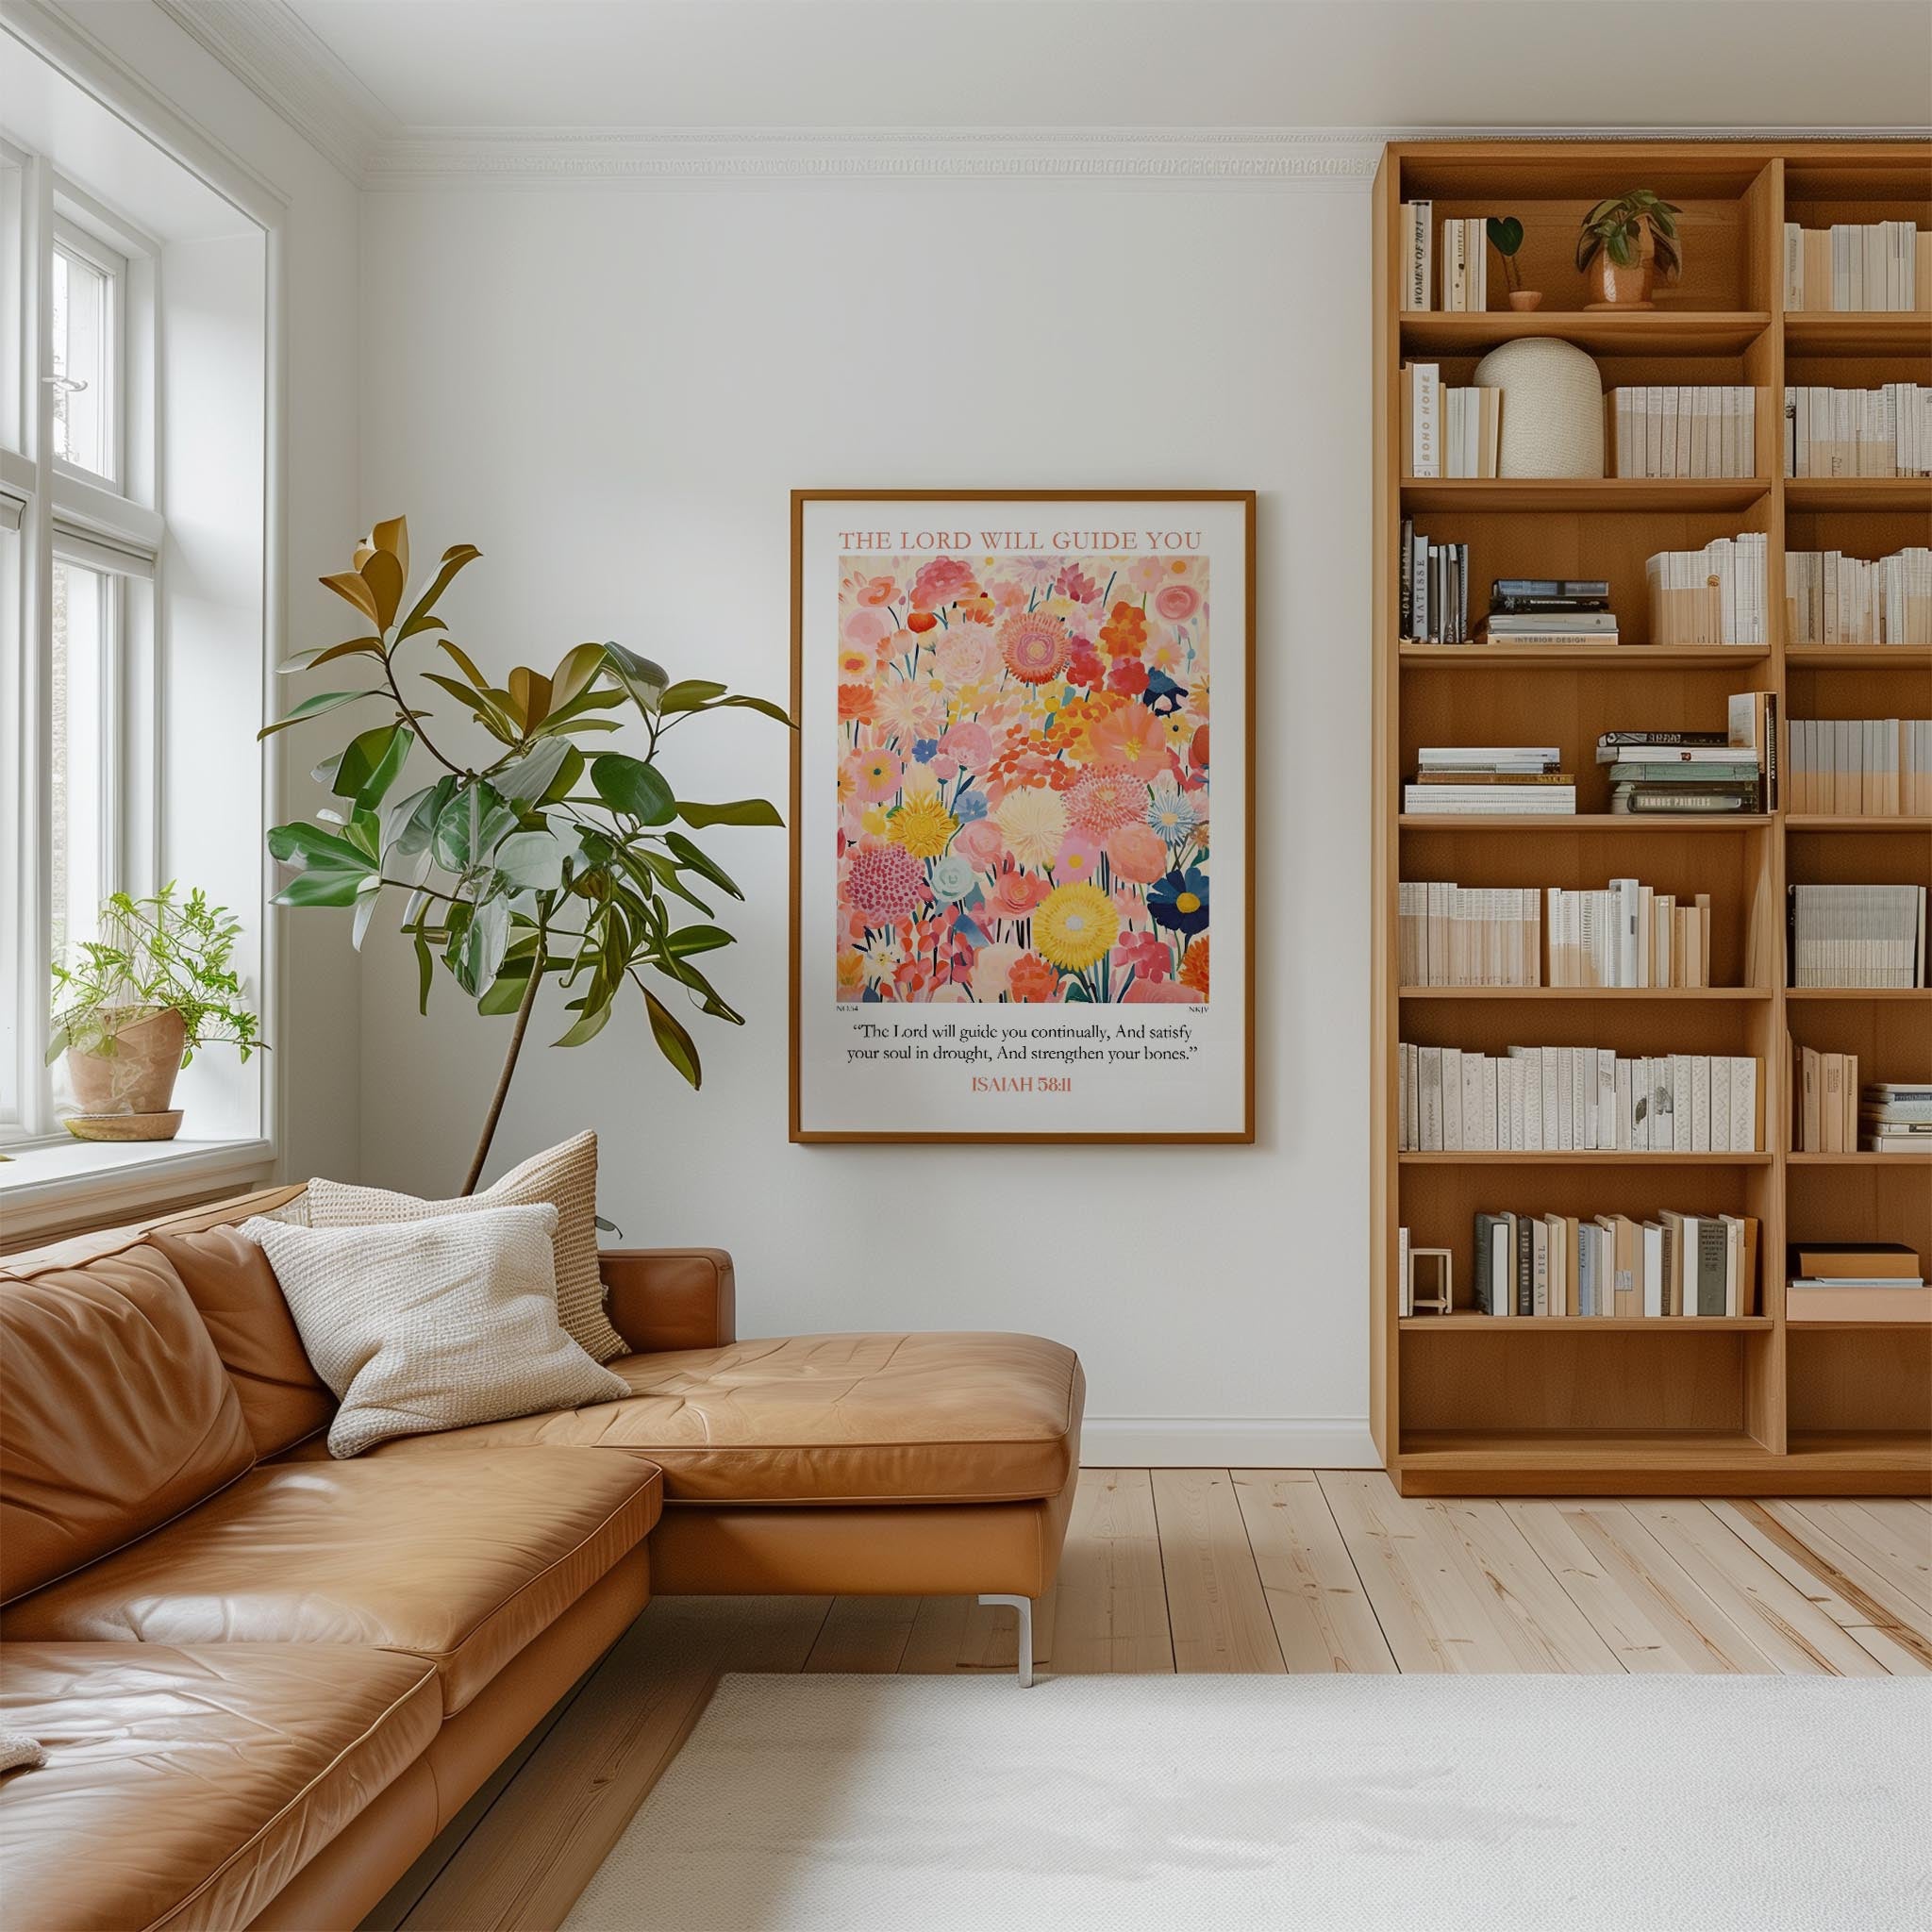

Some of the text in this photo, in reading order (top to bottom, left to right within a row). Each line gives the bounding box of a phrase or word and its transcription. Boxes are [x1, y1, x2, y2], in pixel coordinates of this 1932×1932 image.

[1414, 221, 1424, 305] WOMEN OF 2024
[1422, 375, 1430, 461] BOHO HOME
[839, 531, 1202, 550] THE LORD WILL GUIDE YOU
[1416, 559, 1424, 624] MATISSE
[1640, 798, 1711, 808] FAMOUS PAINTERS
[892, 1023, 928, 1039] Lord
[932, 1024, 956, 1039] will
[958, 1024, 998, 1043] guide
[1002, 1028, 1028, 1043] you
[1031, 1024, 1111, 1043] continually,
[1115, 1024, 1145, 1040] And
[1149, 1024, 1192, 1043] satisfy
[846, 1049, 880, 1064] your
[883, 1044, 911, 1059] soul
[915, 1045, 929, 1059] in
[932, 1044, 993, 1064] drought,
[997, 1045, 1027, 1060] And
[1030, 1045, 1105, 1064] strengthen
[1108, 1050, 1141, 1065] your
[972, 1076, 1072, 1092] ISAIAH 58:11
